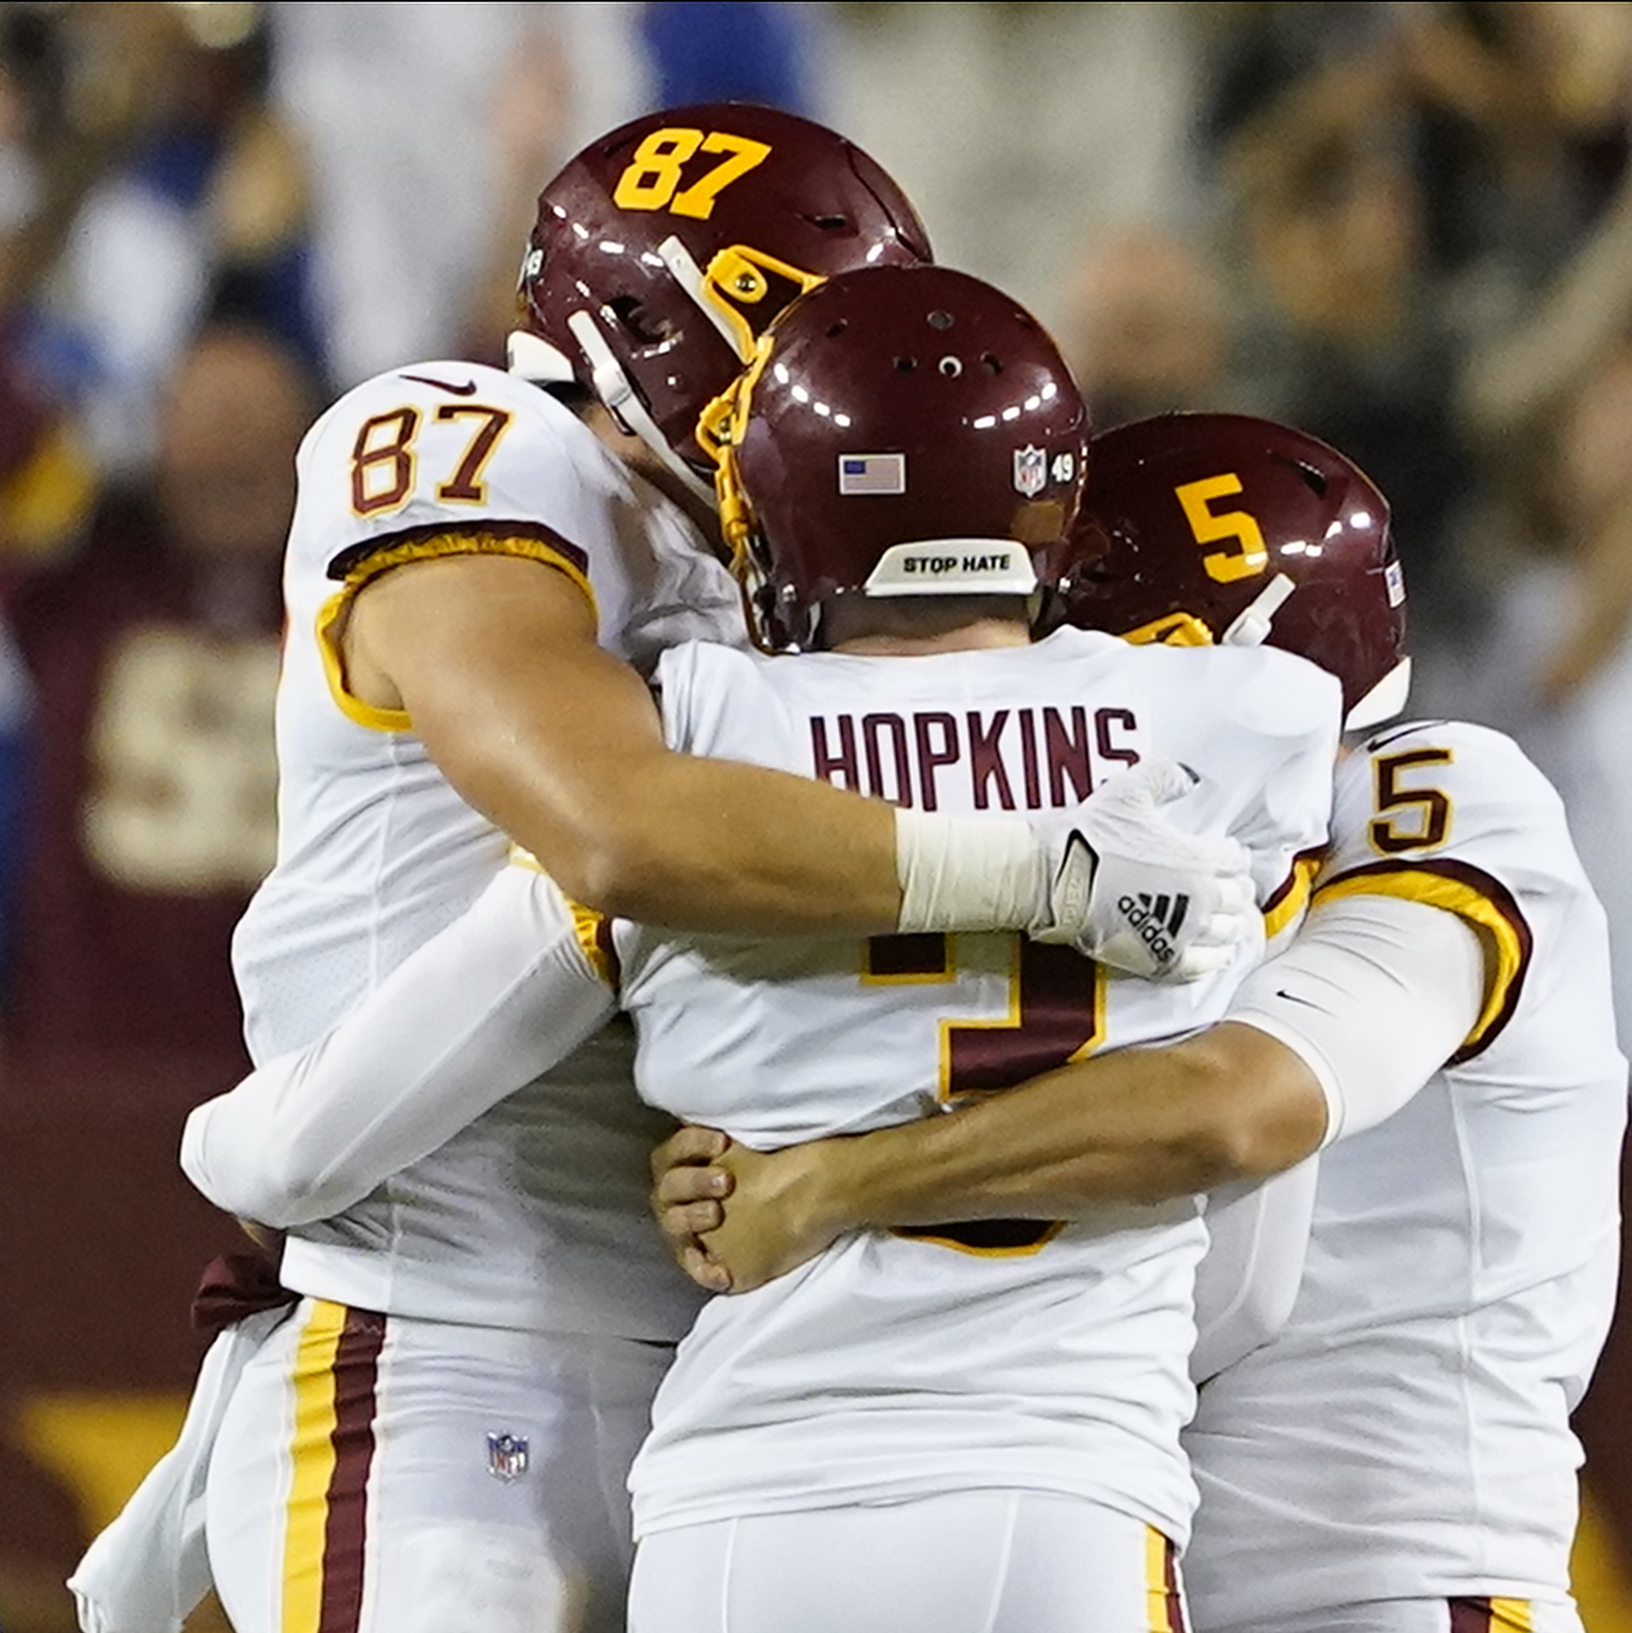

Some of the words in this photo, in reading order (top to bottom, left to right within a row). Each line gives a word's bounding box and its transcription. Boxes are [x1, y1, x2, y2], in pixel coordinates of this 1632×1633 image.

[613, 127, 772, 220] 87
[349, 401, 515, 519] 87
[903, 556, 957, 574] STOP
[962, 553, 1011, 572] HATE
[1174, 472, 1270, 584] 5
[809, 705, 1141, 812] HOPKINS
[1368, 747, 1455, 855] 5
[1117, 894, 1176, 963] adidas
